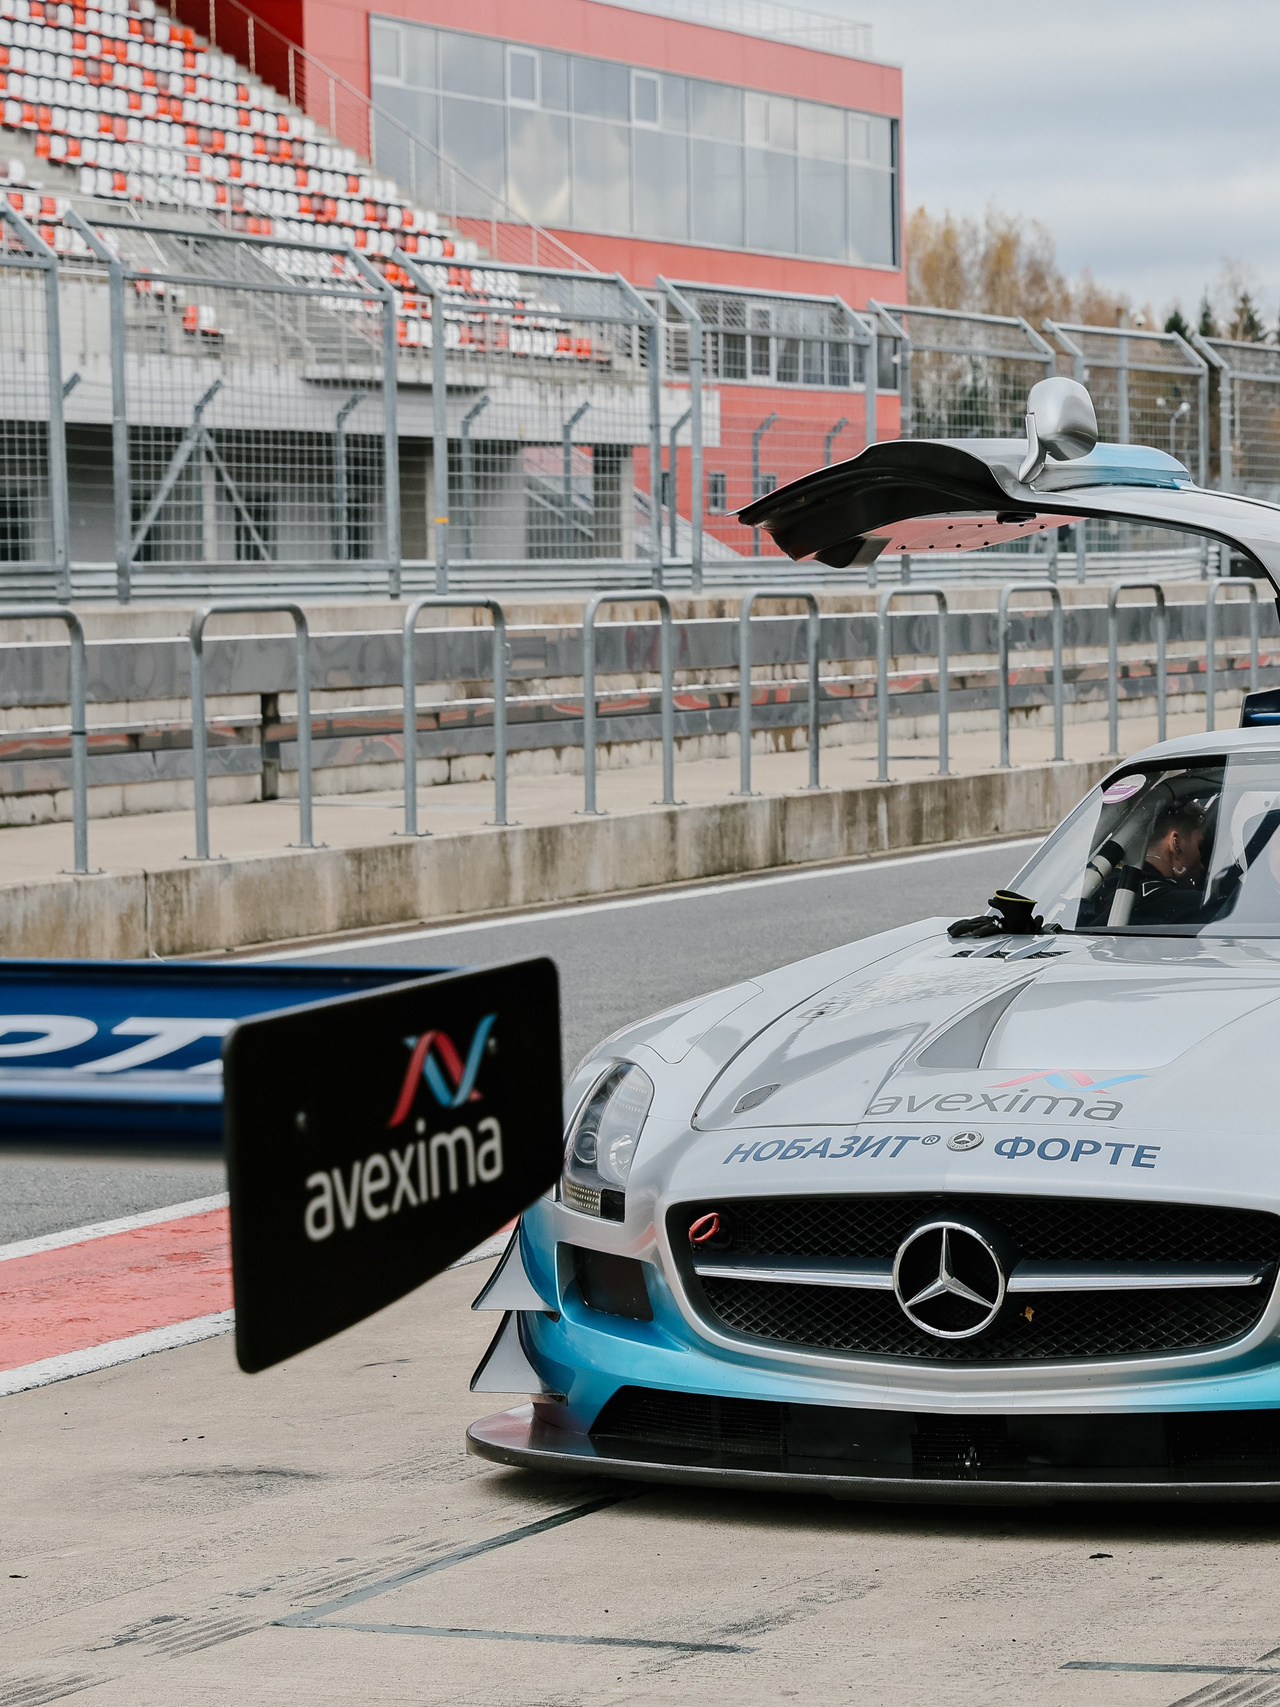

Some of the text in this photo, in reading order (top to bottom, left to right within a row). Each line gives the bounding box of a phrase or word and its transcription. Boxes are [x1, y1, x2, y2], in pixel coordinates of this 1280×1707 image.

[866, 1088, 1124, 1122] avexima
[994, 1135, 1162, 1170] ФОРТЕ
[304, 1116, 504, 1242] avexima
